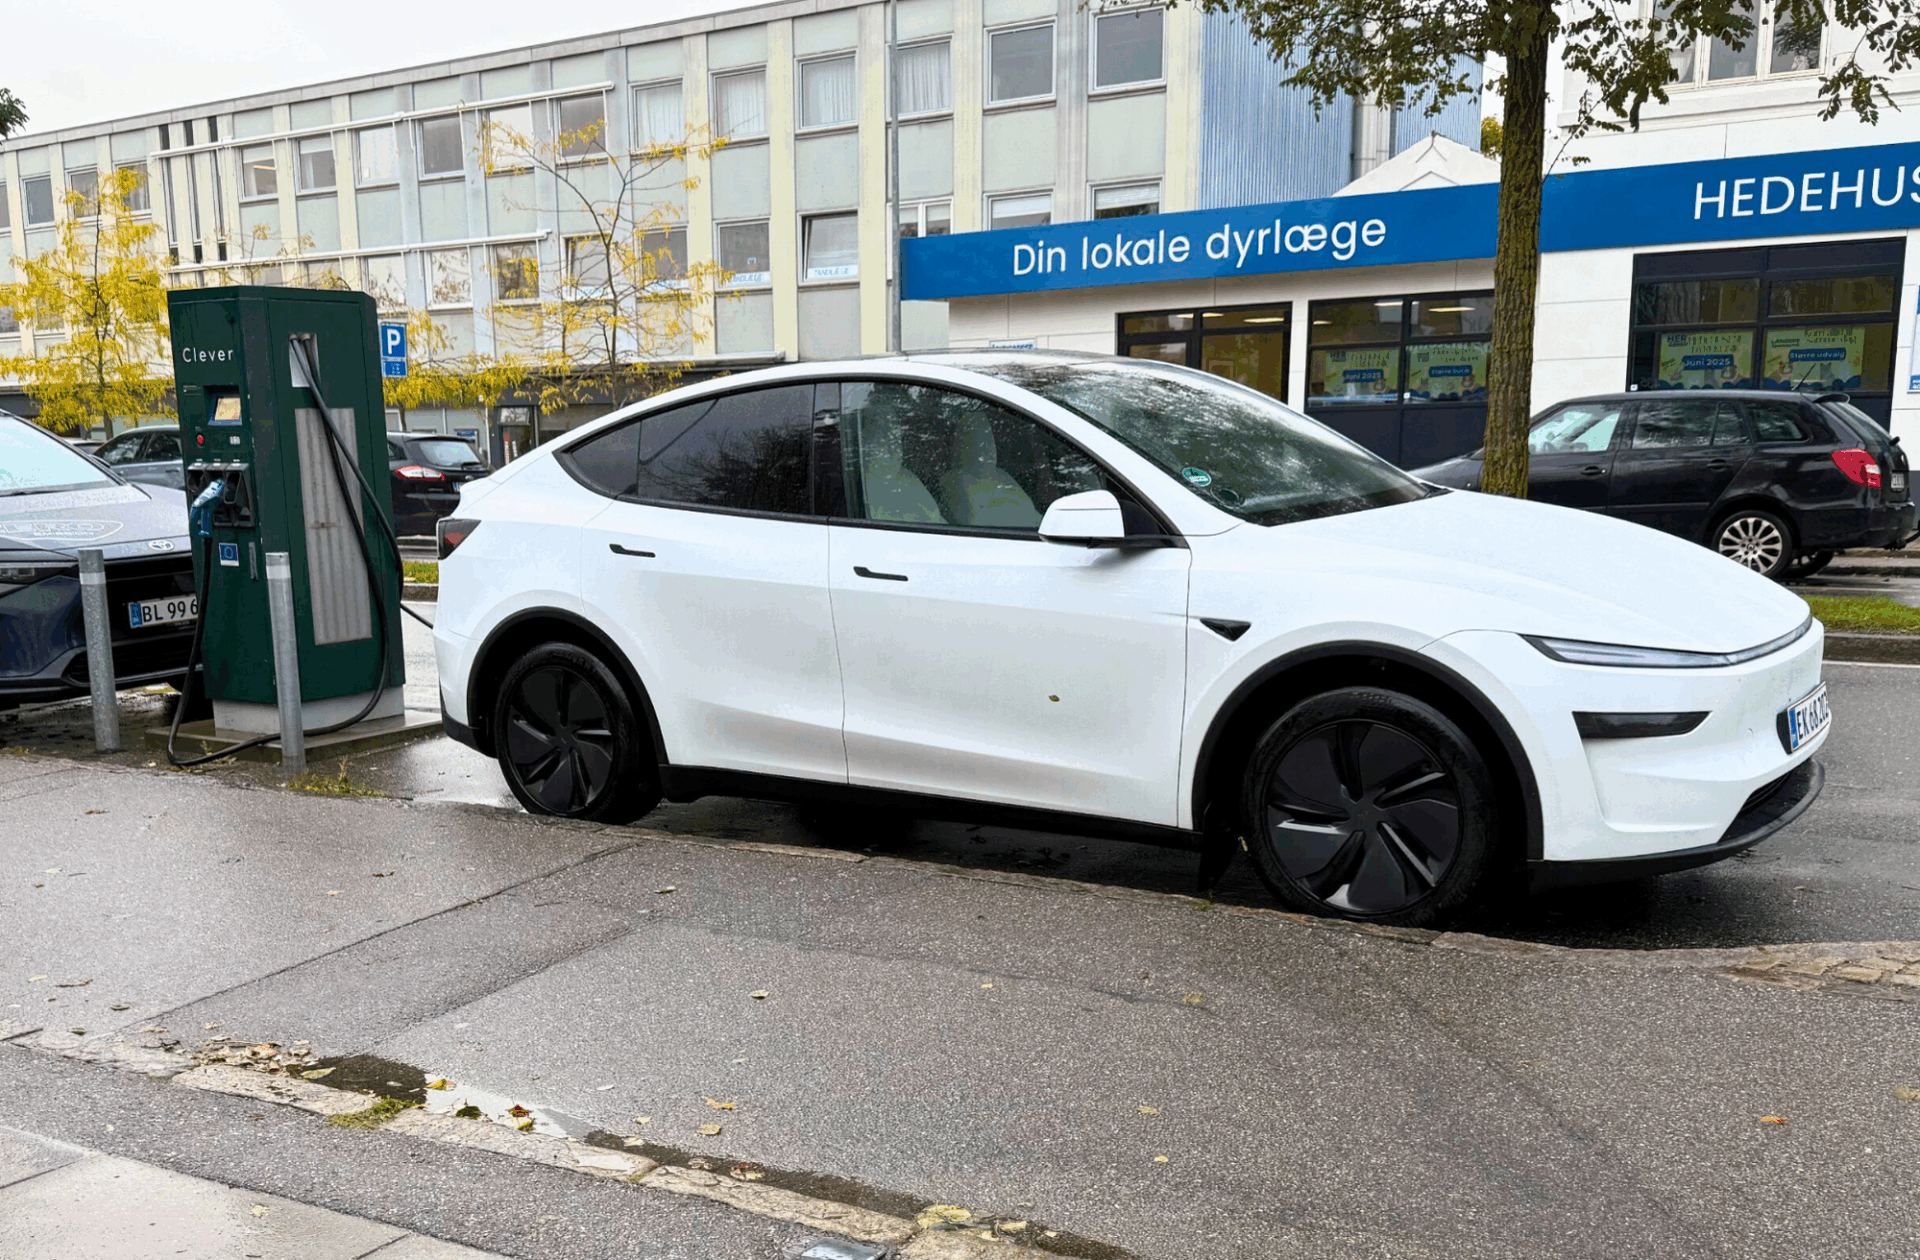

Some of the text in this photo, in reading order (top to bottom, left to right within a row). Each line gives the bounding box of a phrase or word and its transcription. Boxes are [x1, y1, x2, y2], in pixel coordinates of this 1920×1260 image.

[1014, 219, 1386, 275] Din lokale dyrlæge
[387, 328, 401, 355] P
[182, 347, 234, 362] Clever
[1685, 357, 1731, 367] Juni 2025
[142, 604, 164, 623] BL
[167, 600, 186, 620] 99
[1796, 707, 1810, 740] EK
